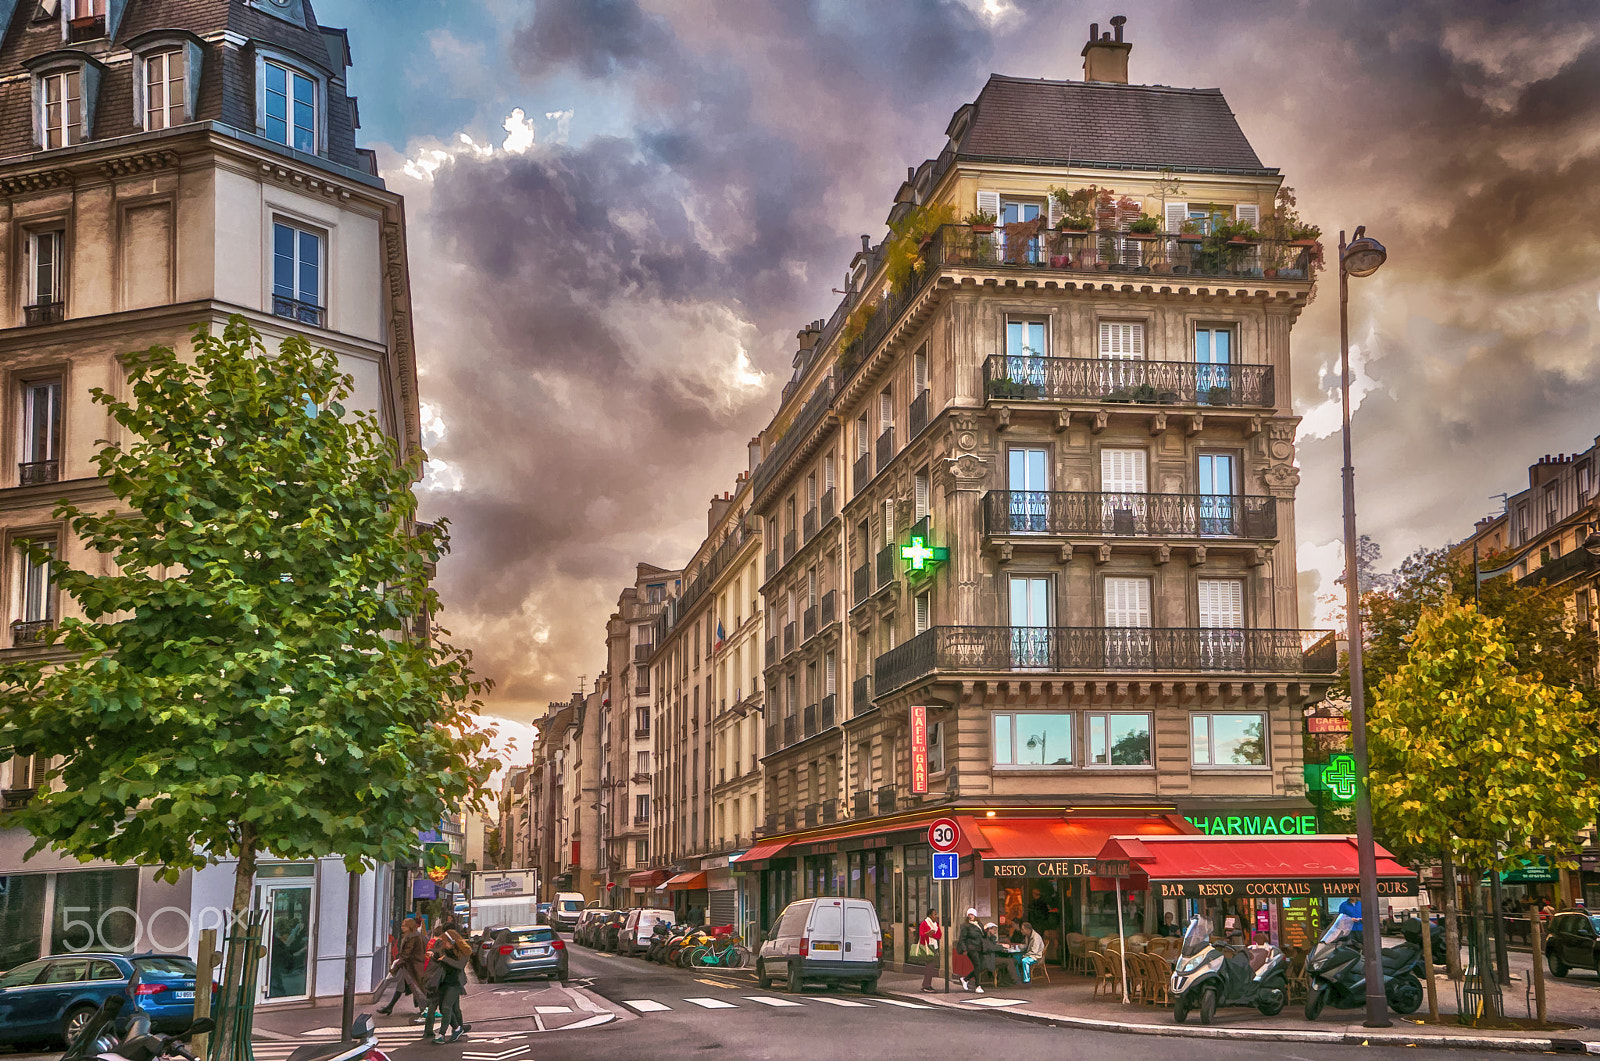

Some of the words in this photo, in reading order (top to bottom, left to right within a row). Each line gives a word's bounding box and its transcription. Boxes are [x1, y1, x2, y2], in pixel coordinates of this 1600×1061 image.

[914, 707, 924, 745] CAFE
[1315, 717, 1340, 725] CAFE
[915, 754, 924, 791] GARE
[1183, 815, 1316, 835] HARMACIE
[934, 827, 954, 843] 30
[993, 865, 1027, 876] RESTO
[1037, 862, 1069, 876] CAFE
[1073, 863, 1089, 875] DE
[1303, 862, 1357, 872] GAR
[1160, 884, 1186, 896] BAR
[1197, 883, 1234, 896] RESTO
[1245, 882, 1311, 895] COCKTAILS
[1322, 882, 1361, 895] HAPPY
[1376, 881, 1409, 894] OURS
